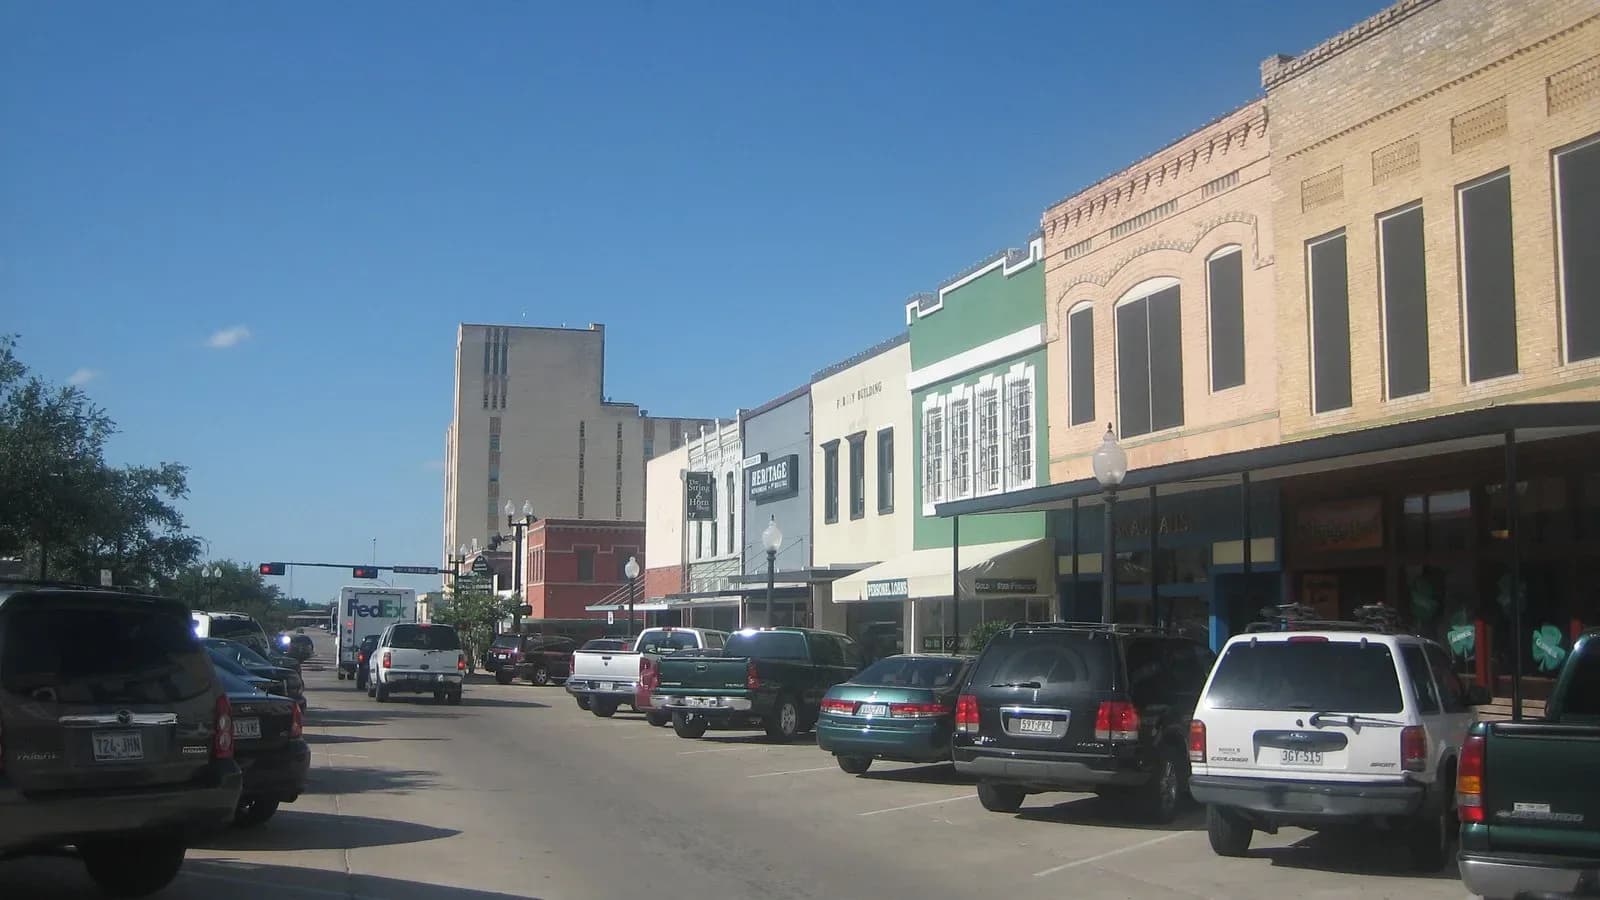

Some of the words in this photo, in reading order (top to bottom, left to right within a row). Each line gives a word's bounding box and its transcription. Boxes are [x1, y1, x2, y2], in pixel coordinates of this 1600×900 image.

[858, 381, 882, 400] BUILDING
[752, 462, 787, 486] HERITAGE
[891, 581, 907, 595] LOANS
[348, 599, 408, 618] FedEx
